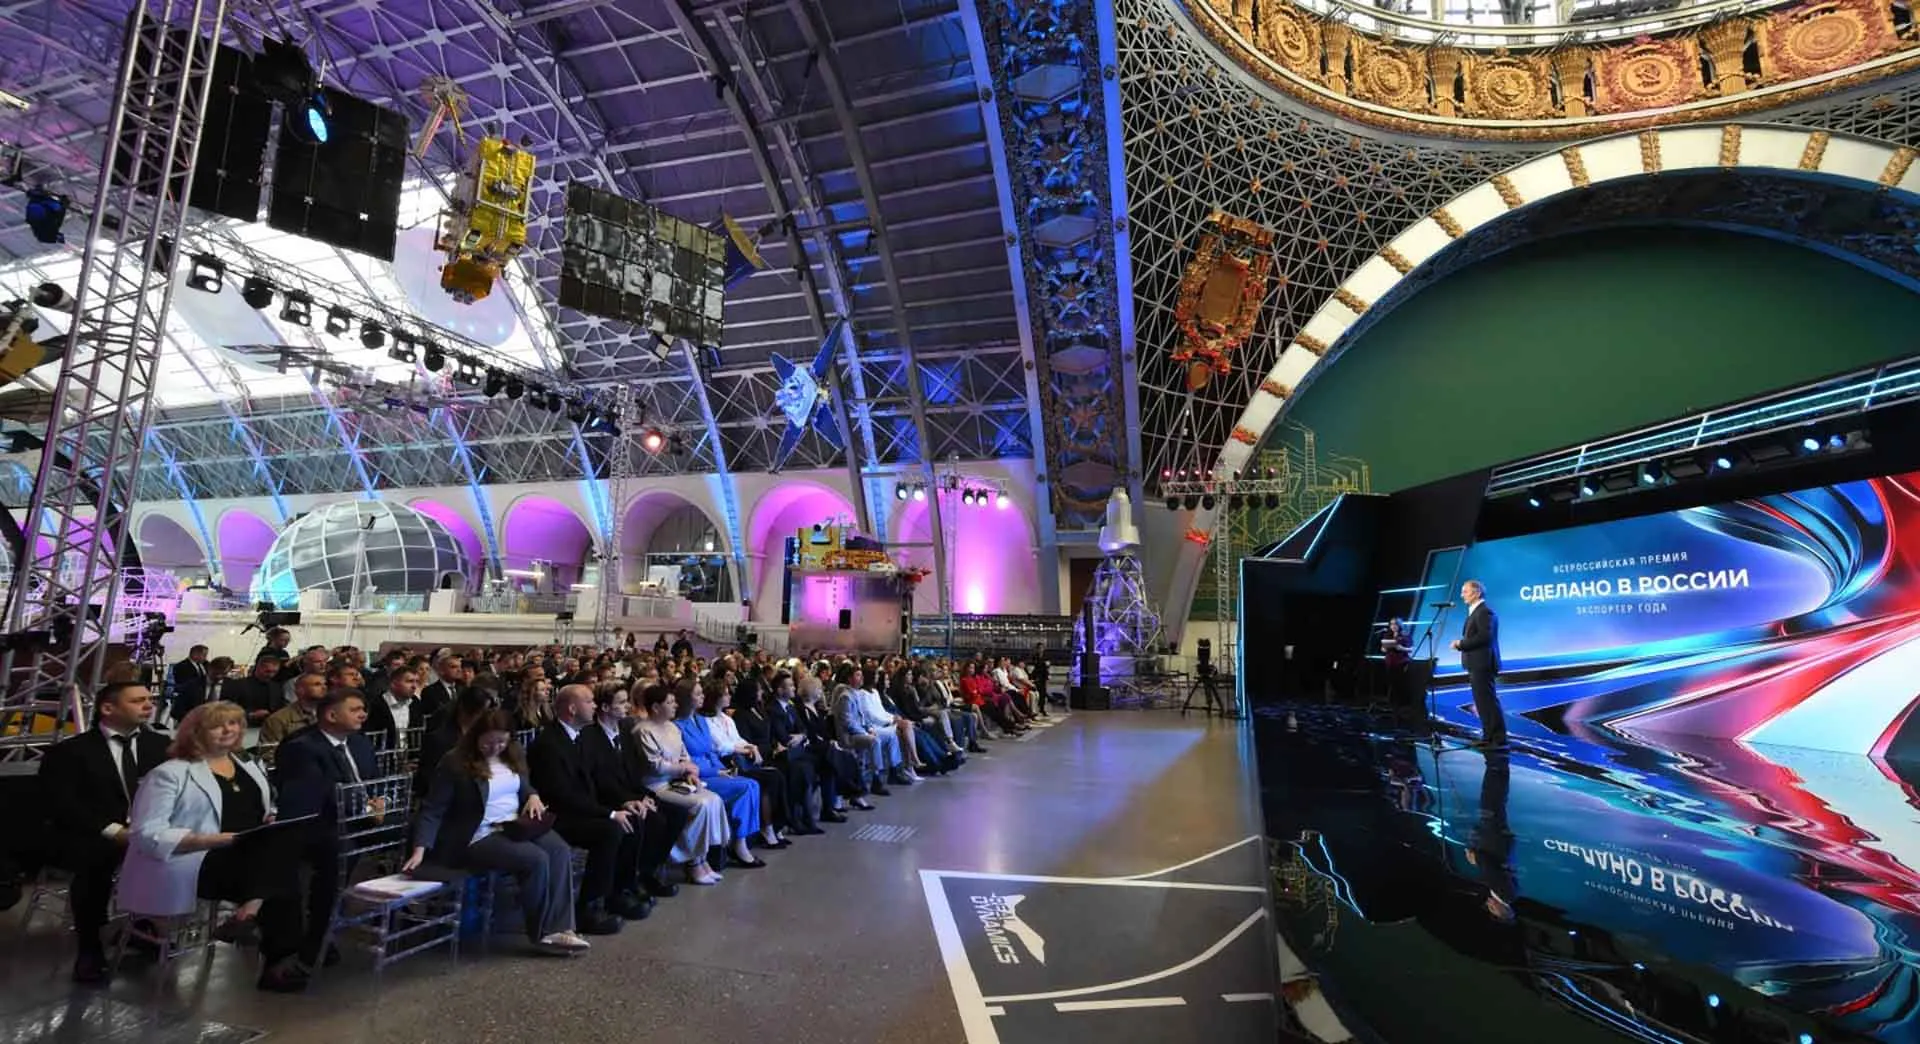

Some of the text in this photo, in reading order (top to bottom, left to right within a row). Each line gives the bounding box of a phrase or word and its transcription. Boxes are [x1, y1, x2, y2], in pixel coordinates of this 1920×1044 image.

[1553, 551, 1688, 574] ВСЕРОССИЙСКАЯ ПРЕМИЯ
[1520, 568, 1750, 602] СДЕЛАНО В РОССИИ
[1576, 602, 1668, 616] ЭКСПОРТЕР ГОДА
[970, 895, 1020, 964] DYNAMICS
